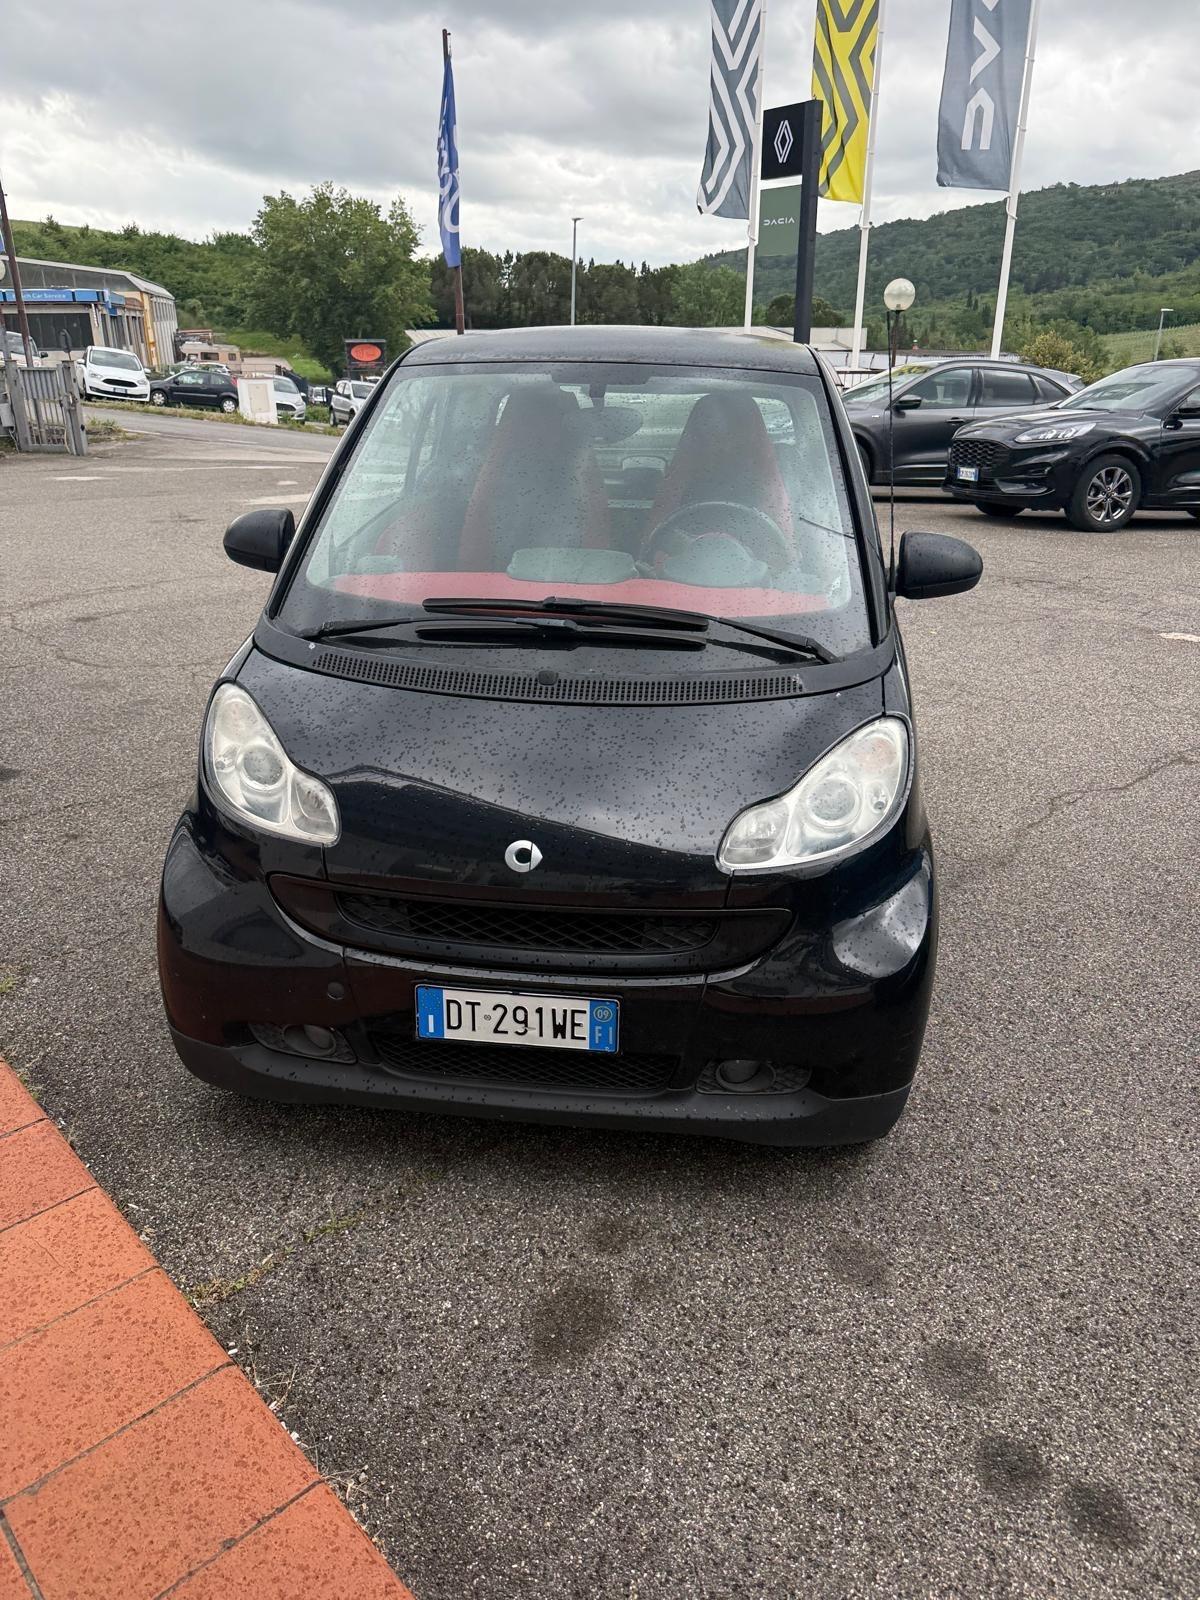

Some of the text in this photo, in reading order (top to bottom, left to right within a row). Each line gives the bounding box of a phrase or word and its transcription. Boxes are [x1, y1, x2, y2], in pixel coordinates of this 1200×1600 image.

[763, 217, 795, 226] DACIA
[446, 999, 587, 1041] DT 291WE
[595, 1010, 610, 1020] 09
